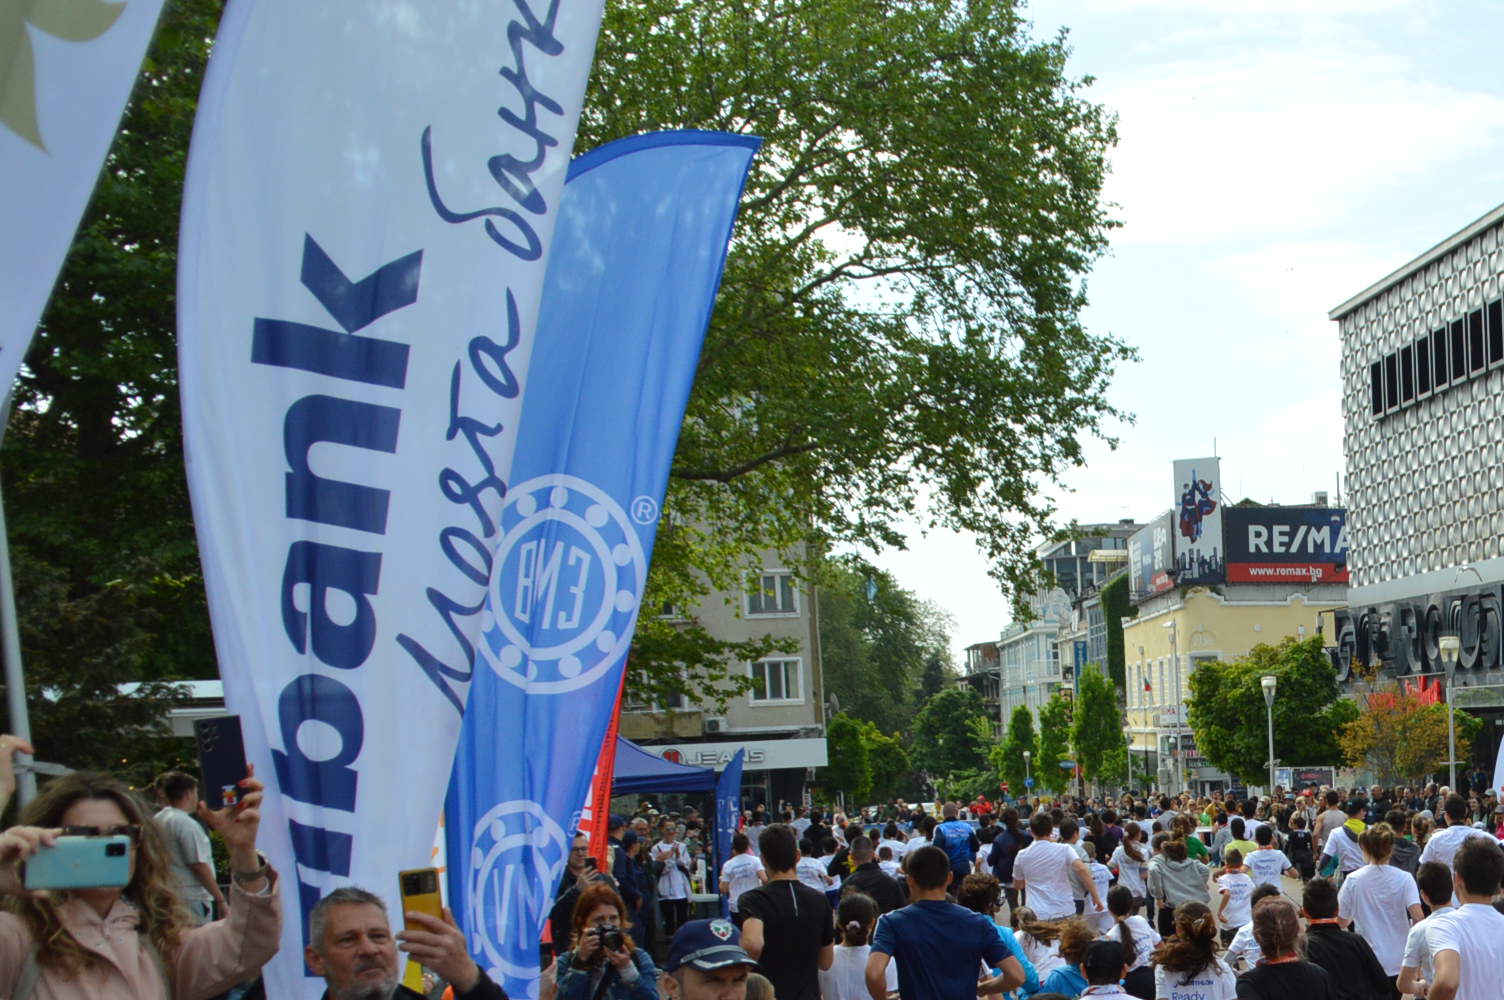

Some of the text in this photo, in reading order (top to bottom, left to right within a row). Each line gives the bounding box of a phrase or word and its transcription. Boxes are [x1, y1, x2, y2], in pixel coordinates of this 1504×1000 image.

[420, 0, 565, 261] банк
[244, 232, 424, 978] ibank
[1249, 565, 1323, 578] www.remax.bg
